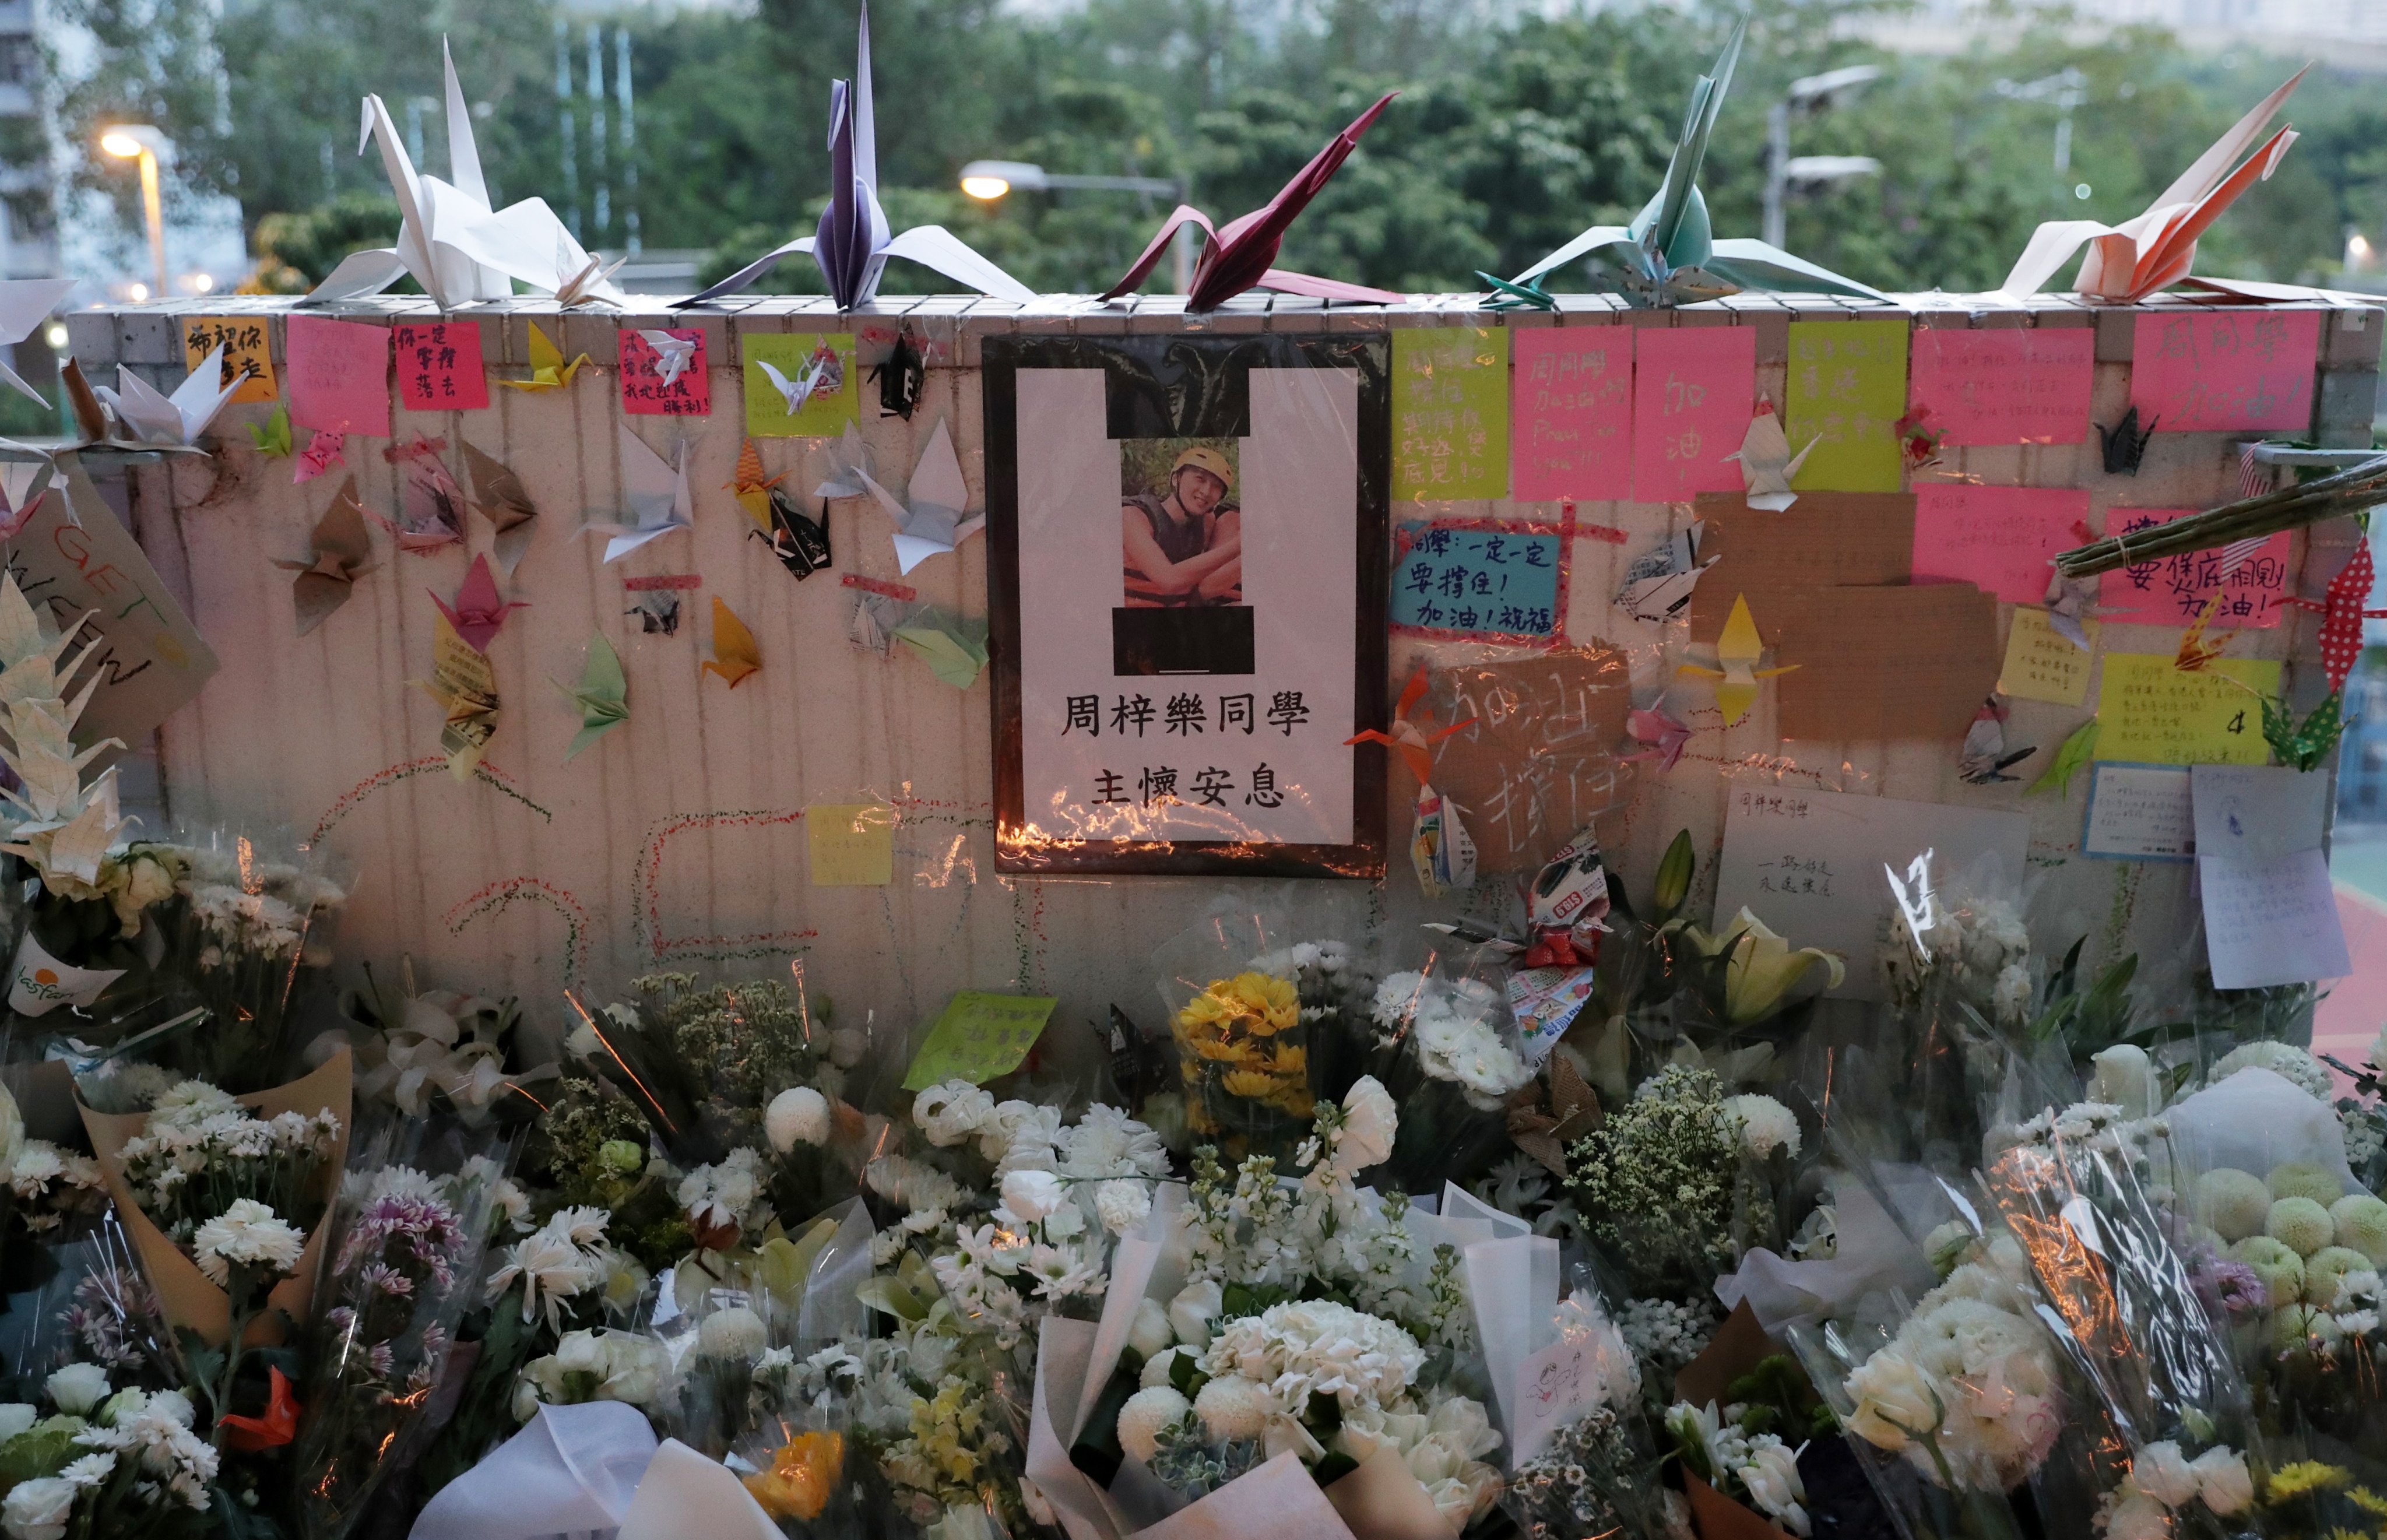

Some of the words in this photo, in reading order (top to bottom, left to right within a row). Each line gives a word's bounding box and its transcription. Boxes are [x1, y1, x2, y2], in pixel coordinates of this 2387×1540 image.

[187, 323, 262, 360] 希望你
[397, 324, 448, 350] 你一定
[2155, 315, 2289, 371] 周同學
[1528, 347, 1607, 387] 周同學
[663, 397, 709, 414] 勝利!
[2170, 375, 2304, 425] 加油!
[54, 524, 169, 627] GET
[1405, 562, 1509, 602] 要撐住!
[1416, 598, 1552, 634] 加油!祝福
[1060, 690, 1311, 739] 周梓樂同學
[1090, 761, 1286, 810] 主懷安息
[1757, 855, 1834, 877] 一路好走
